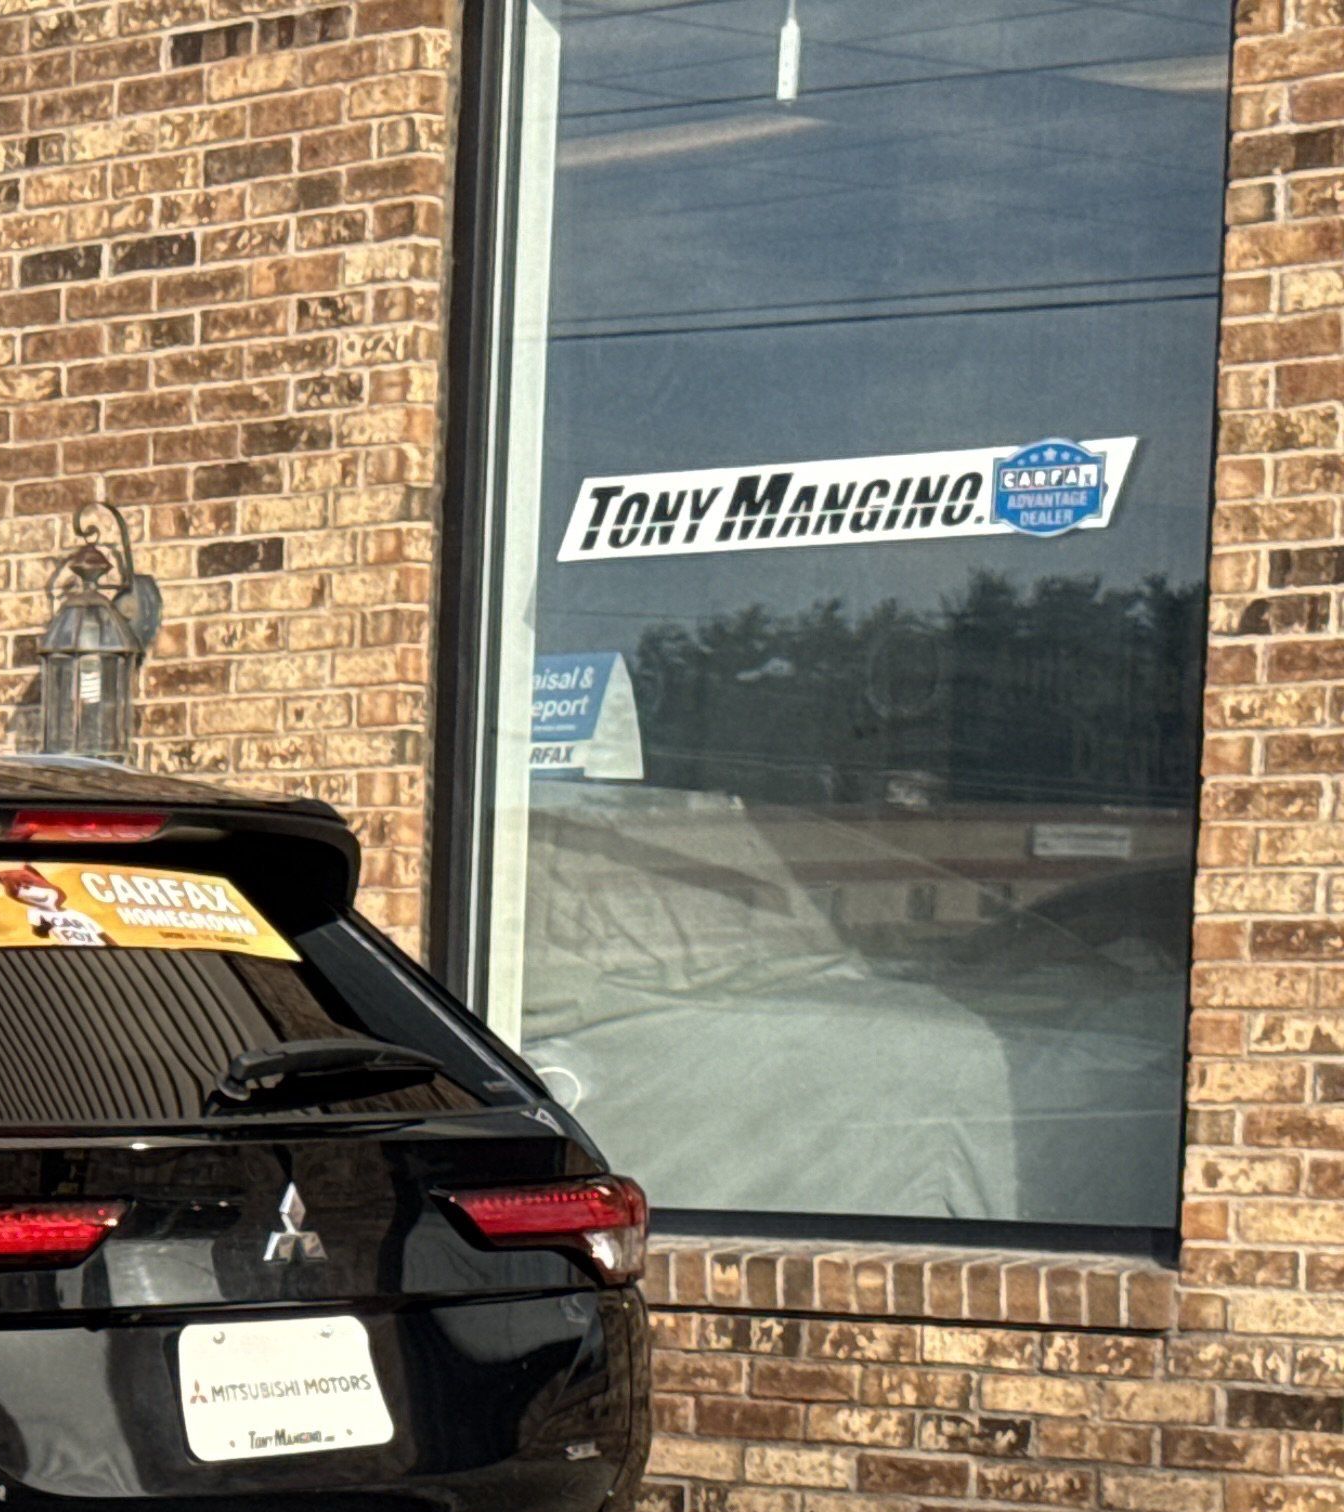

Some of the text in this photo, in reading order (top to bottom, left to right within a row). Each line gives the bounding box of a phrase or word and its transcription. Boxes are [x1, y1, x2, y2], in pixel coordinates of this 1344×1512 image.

[1002, 465, 1097, 490] CARFAX
[1007, 491, 1087, 509] ADVANTAGE
[580, 486, 722, 551] TONY
[1019, 509, 1074, 526] DEALER
[580, 665, 595, 689] &
[80, 872, 241, 915] CARFAX
[115, 907, 258, 937] HOMEGROWN
[211, 1374, 372, 1403] MITSUBISHI MOTORS
